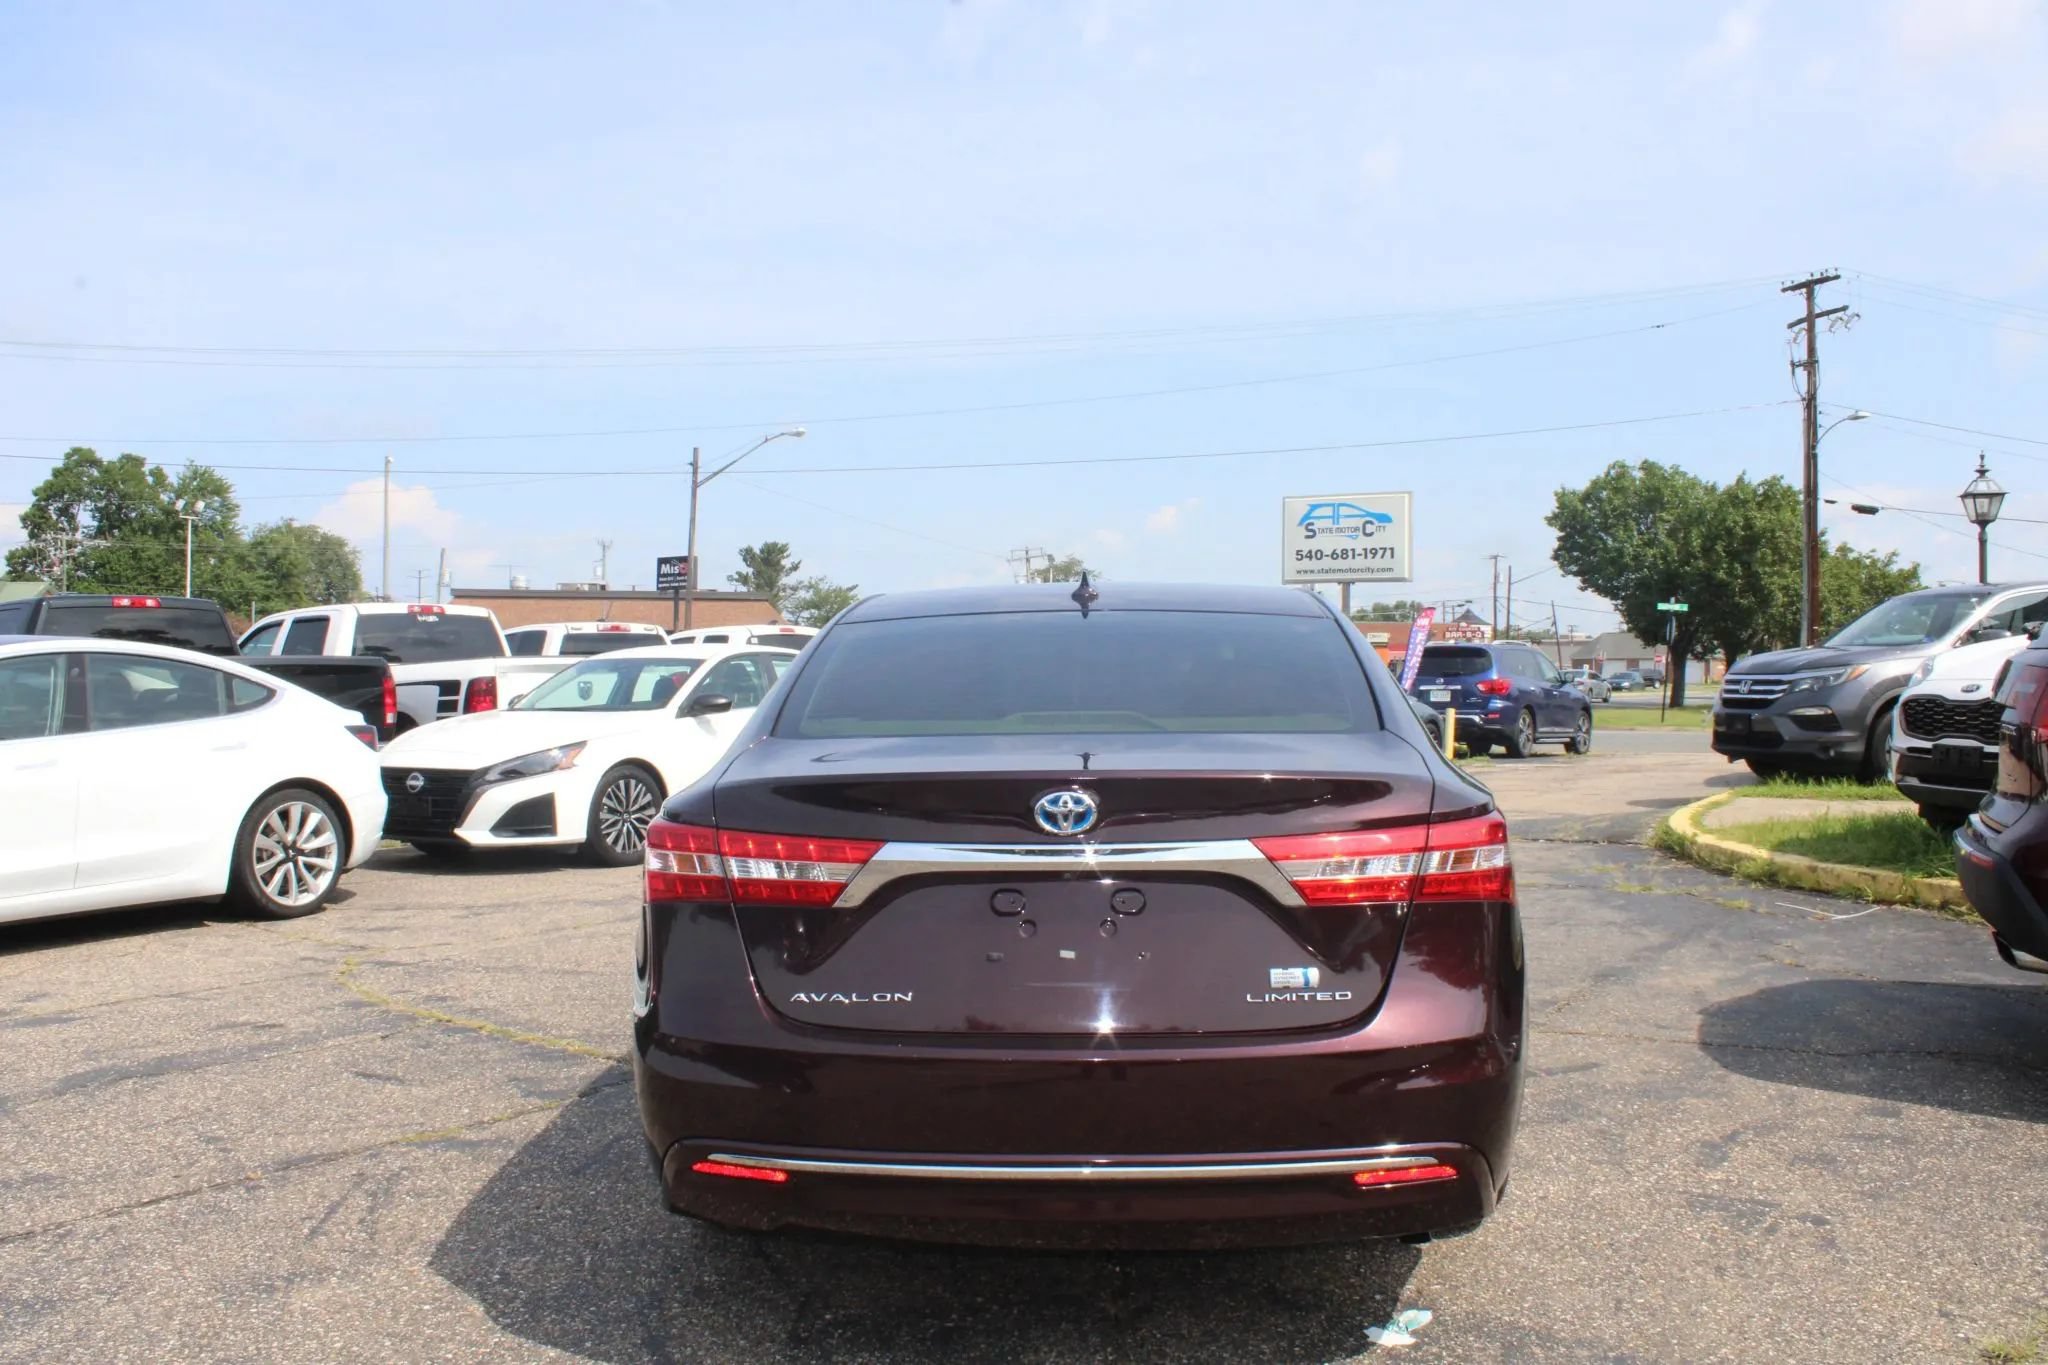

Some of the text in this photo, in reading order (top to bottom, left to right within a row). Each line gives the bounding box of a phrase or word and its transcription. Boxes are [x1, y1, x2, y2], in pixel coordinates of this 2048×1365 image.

[1304, 520, 1386, 539] STATE MOTOR CITY
[1295, 547, 1395, 561] 540-681-1971
[1296, 566, 1394, 577] www.statemotorcity.com
[789, 992, 913, 1003] AVALON
[1246, 991, 1352, 1002] LIMITED
